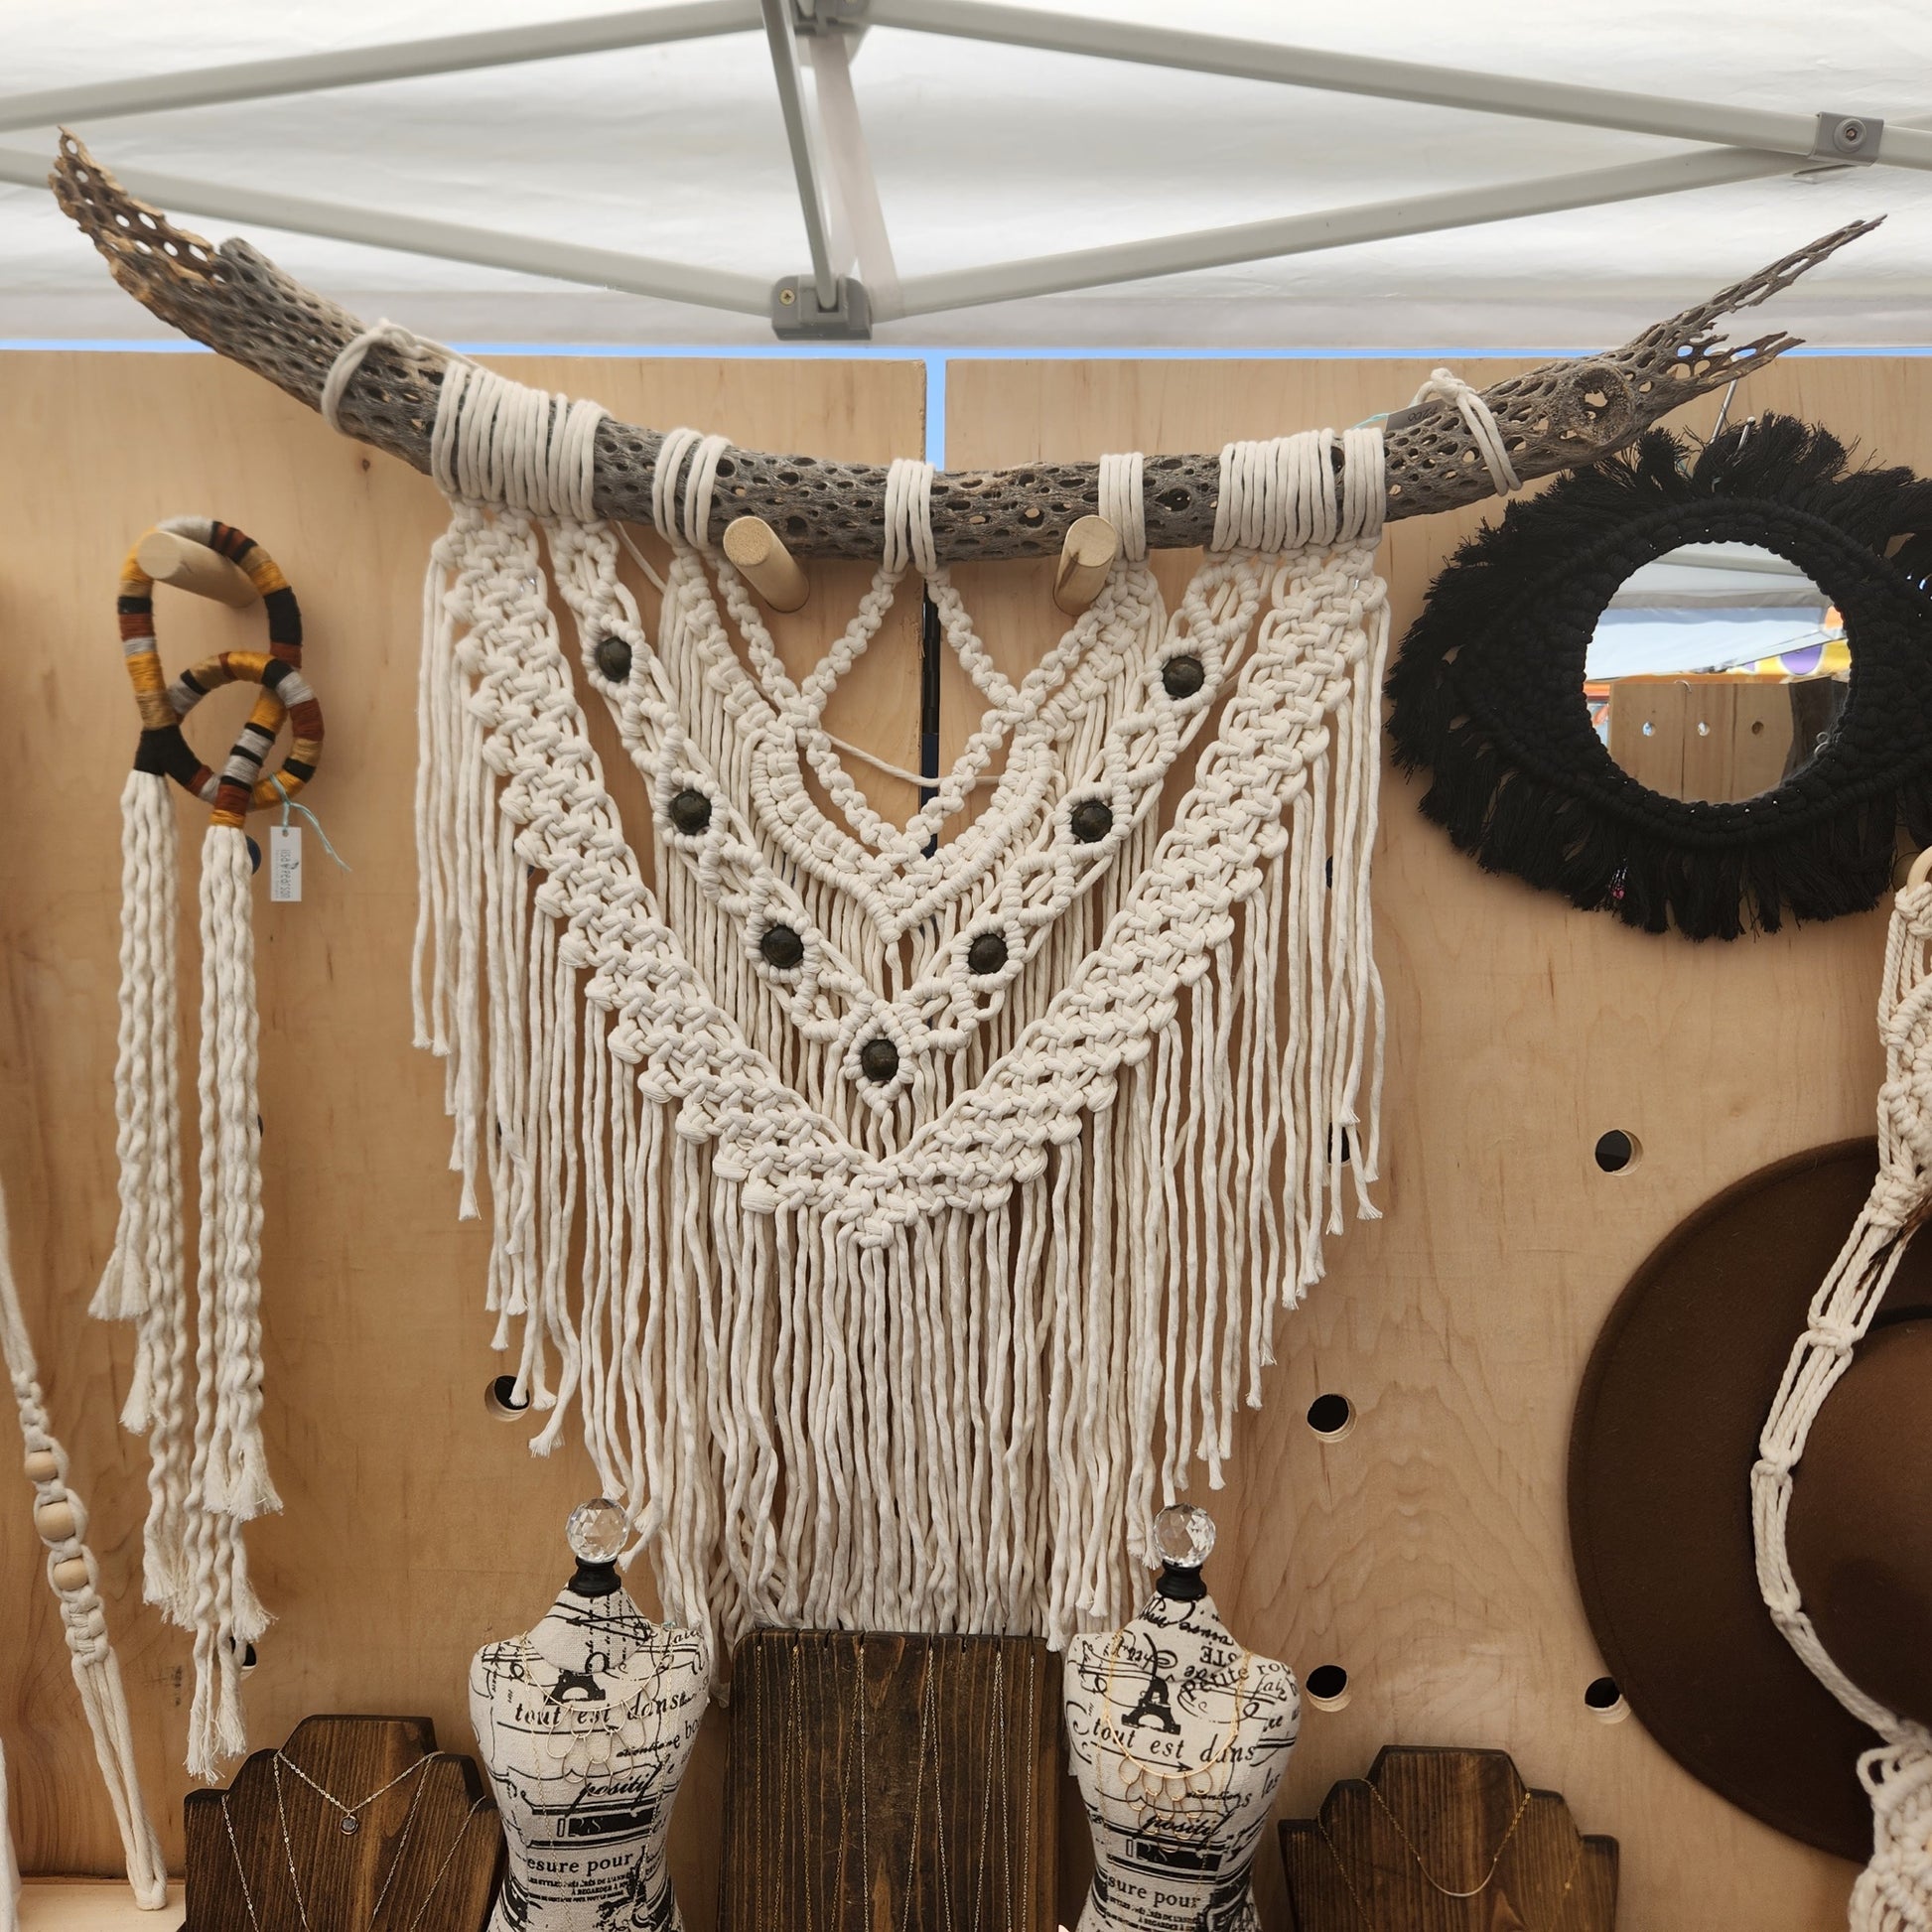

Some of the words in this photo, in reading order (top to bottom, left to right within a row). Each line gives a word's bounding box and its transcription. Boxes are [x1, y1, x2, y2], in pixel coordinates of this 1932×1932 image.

[514, 1703, 562, 1725] tout
[577, 1703, 612, 1725] est
[626, 1692, 679, 1722] dans
[1093, 1718, 1137, 1748] tout
[1150, 1738, 1184, 1758] est
[1199, 1733, 1255, 1763] dans
[587, 1853, 633, 1876] pour
[1154, 1890, 1202, 1908] pour
